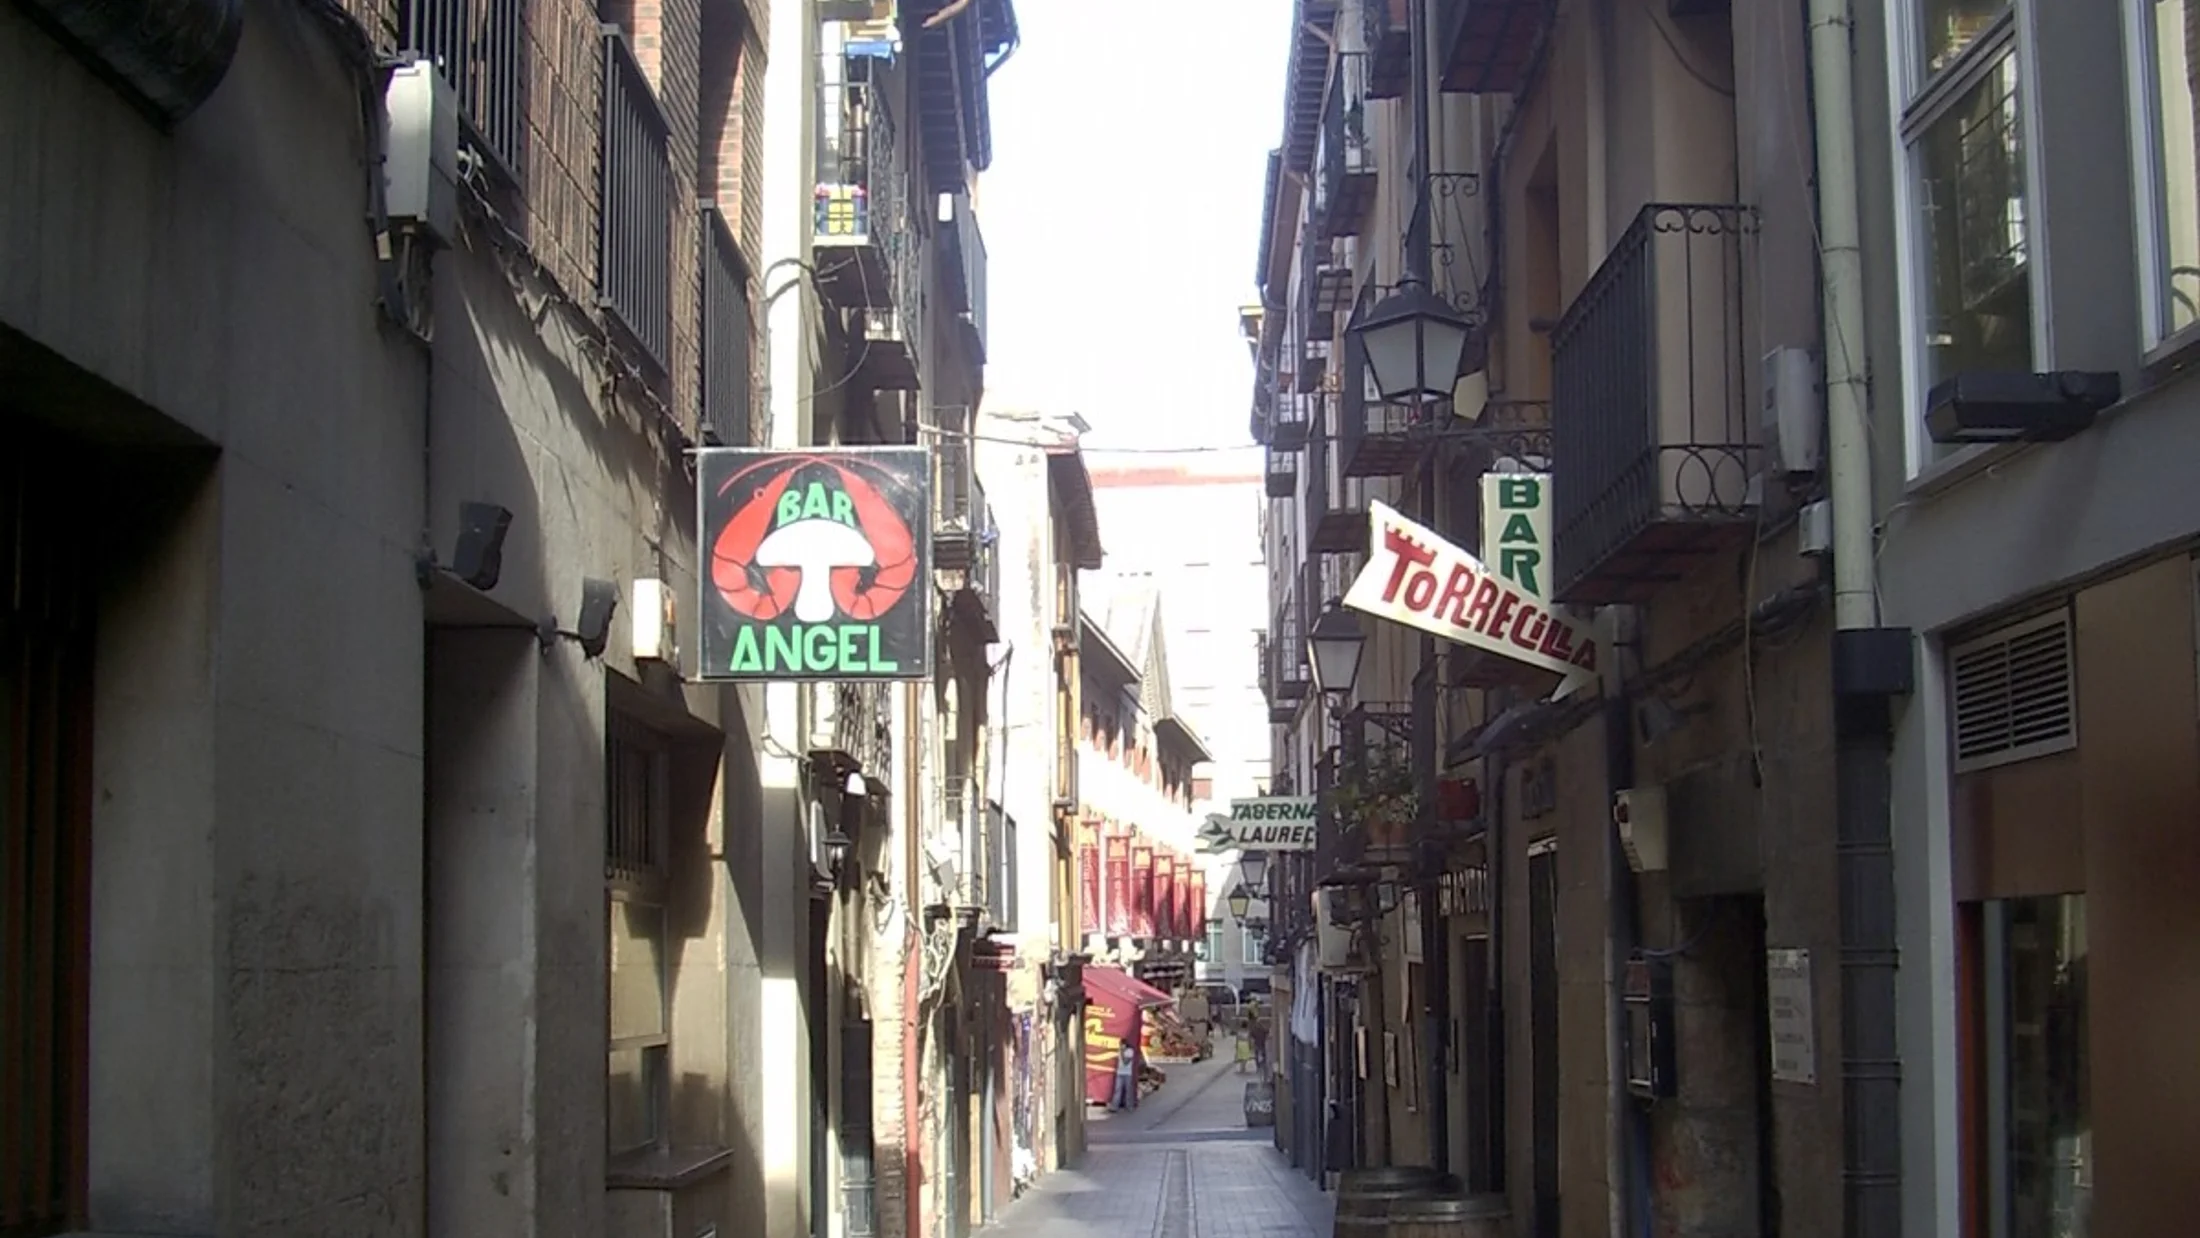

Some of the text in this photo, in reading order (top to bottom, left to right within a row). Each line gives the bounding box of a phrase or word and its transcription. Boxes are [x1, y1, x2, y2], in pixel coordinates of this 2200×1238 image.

[777, 482, 856, 529] BAR
[1499, 479, 1541, 597] BAR
[729, 624, 898, 672] ANGEL
